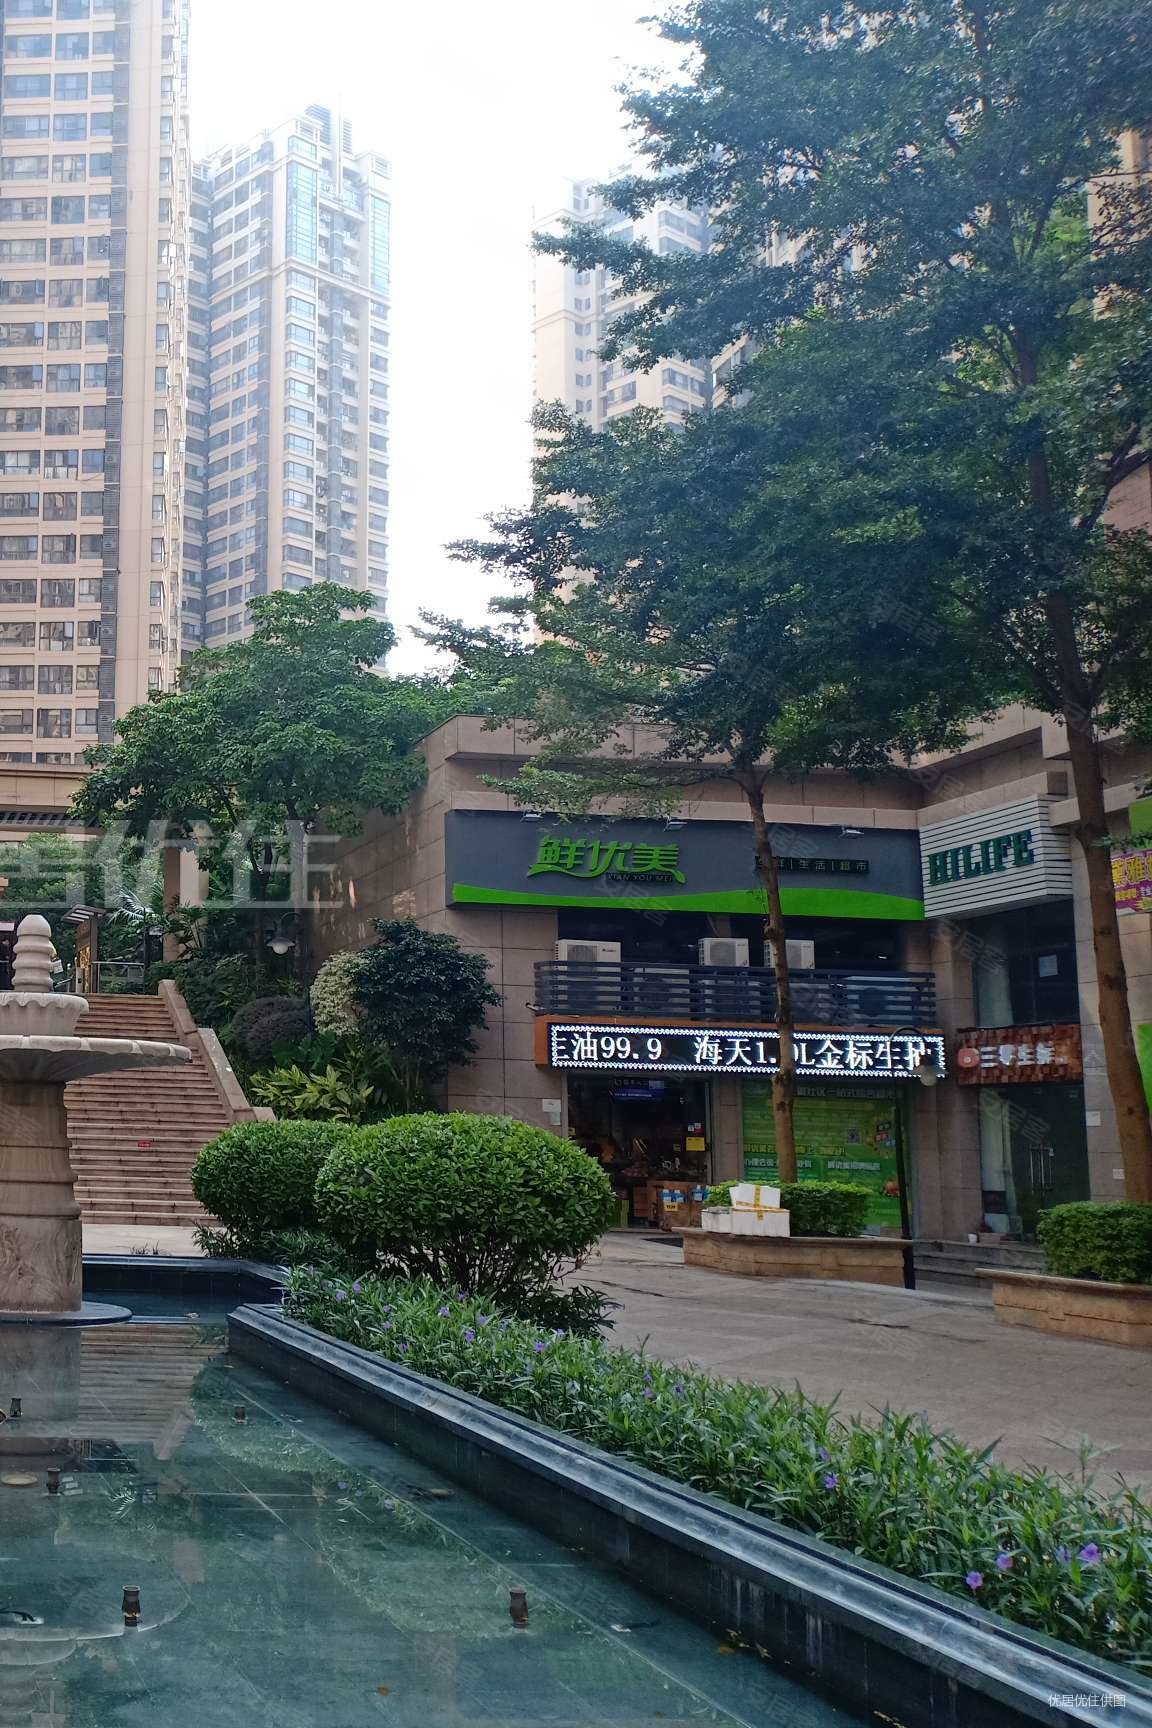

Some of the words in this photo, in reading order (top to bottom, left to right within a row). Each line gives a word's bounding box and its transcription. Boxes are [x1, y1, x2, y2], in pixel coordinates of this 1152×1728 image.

[526, 835, 686, 884] 鲜优美
[928, 830, 1035, 886] HILIFE
